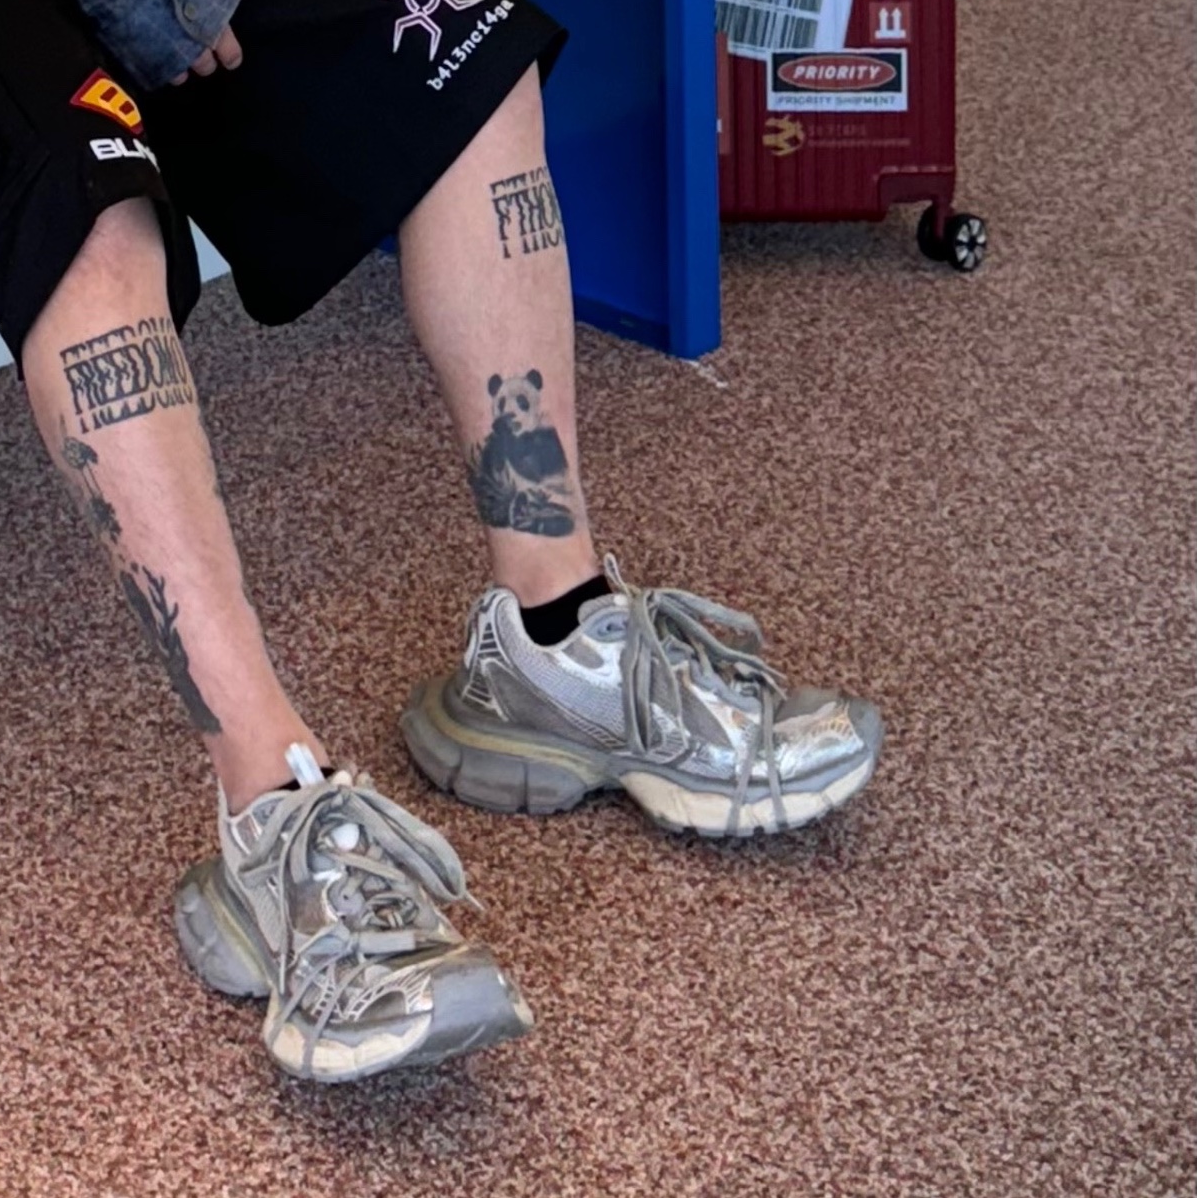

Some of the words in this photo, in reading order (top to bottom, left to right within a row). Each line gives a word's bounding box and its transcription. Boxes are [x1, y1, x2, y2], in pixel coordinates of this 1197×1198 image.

[793, 65, 882, 80] PRIORITY
[777, 96, 832, 106] PRIORITY
[834, 96, 896, 106] SHIPMENT
